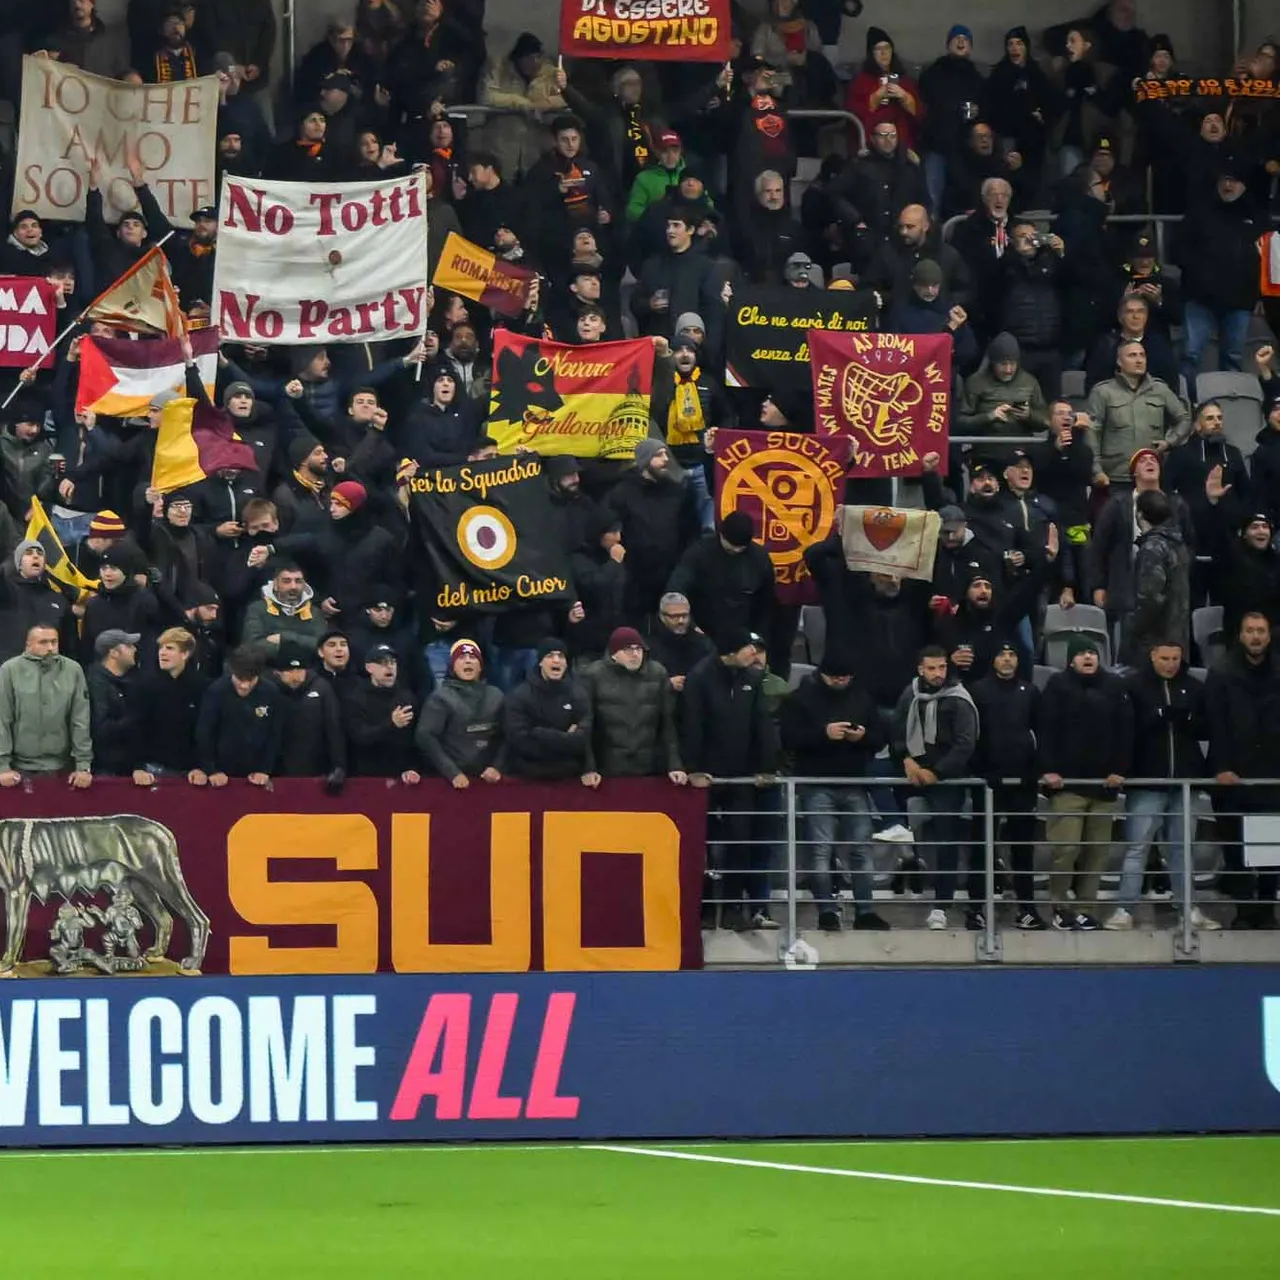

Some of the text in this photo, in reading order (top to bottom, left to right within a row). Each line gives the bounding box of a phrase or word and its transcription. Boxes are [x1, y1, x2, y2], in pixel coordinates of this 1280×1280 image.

[573, 15, 719, 46] AGOSTINO
[41, 70, 204, 125] IO CHE
[59, 124, 172, 171] AMO
[21, 164, 141, 213] SOO
[224, 177, 424, 236] No Totti
[219, 286, 425, 339] No Party
[737, 306, 869, 331] Che ne sarà di noi
[534, 349, 616, 378] Novara
[750, 346, 793, 362] senza
[852, 333, 916, 358] AS ROMA
[819, 363, 839, 409] MATES
[926, 391, 947, 433] BEER
[410, 459, 542, 501] sei la Squadra
[716, 431, 845, 492] NO SOCIAL
[881, 446, 920, 471] TEAM
[437, 575, 568, 608] del mio Cuor
[227, 811, 681, 975] SUD
[388, 991, 581, 1121] ALL
